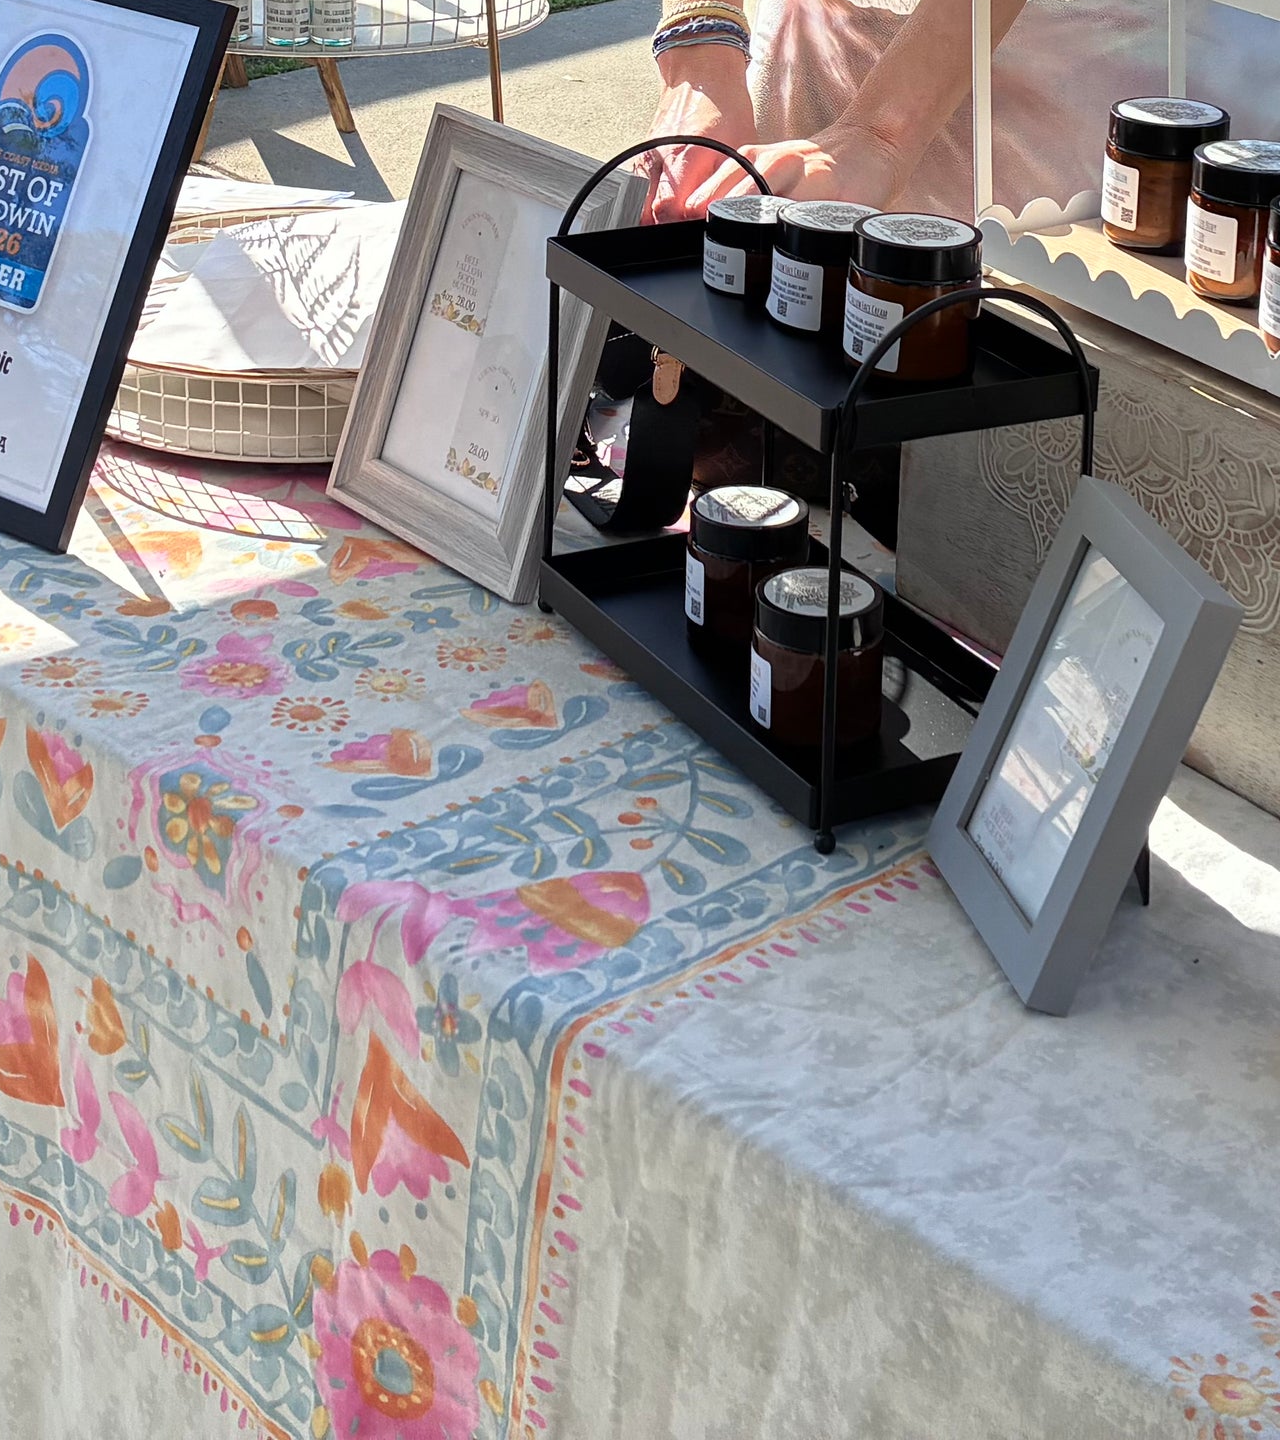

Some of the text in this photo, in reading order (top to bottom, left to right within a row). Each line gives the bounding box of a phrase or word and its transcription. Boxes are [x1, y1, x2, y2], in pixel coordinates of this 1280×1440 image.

[4, 151, 31, 167] COAST
[32, 159, 60, 175] MEDIA
[27, 176, 64, 208] OF
[468, 442, 489, 461] 28.00
